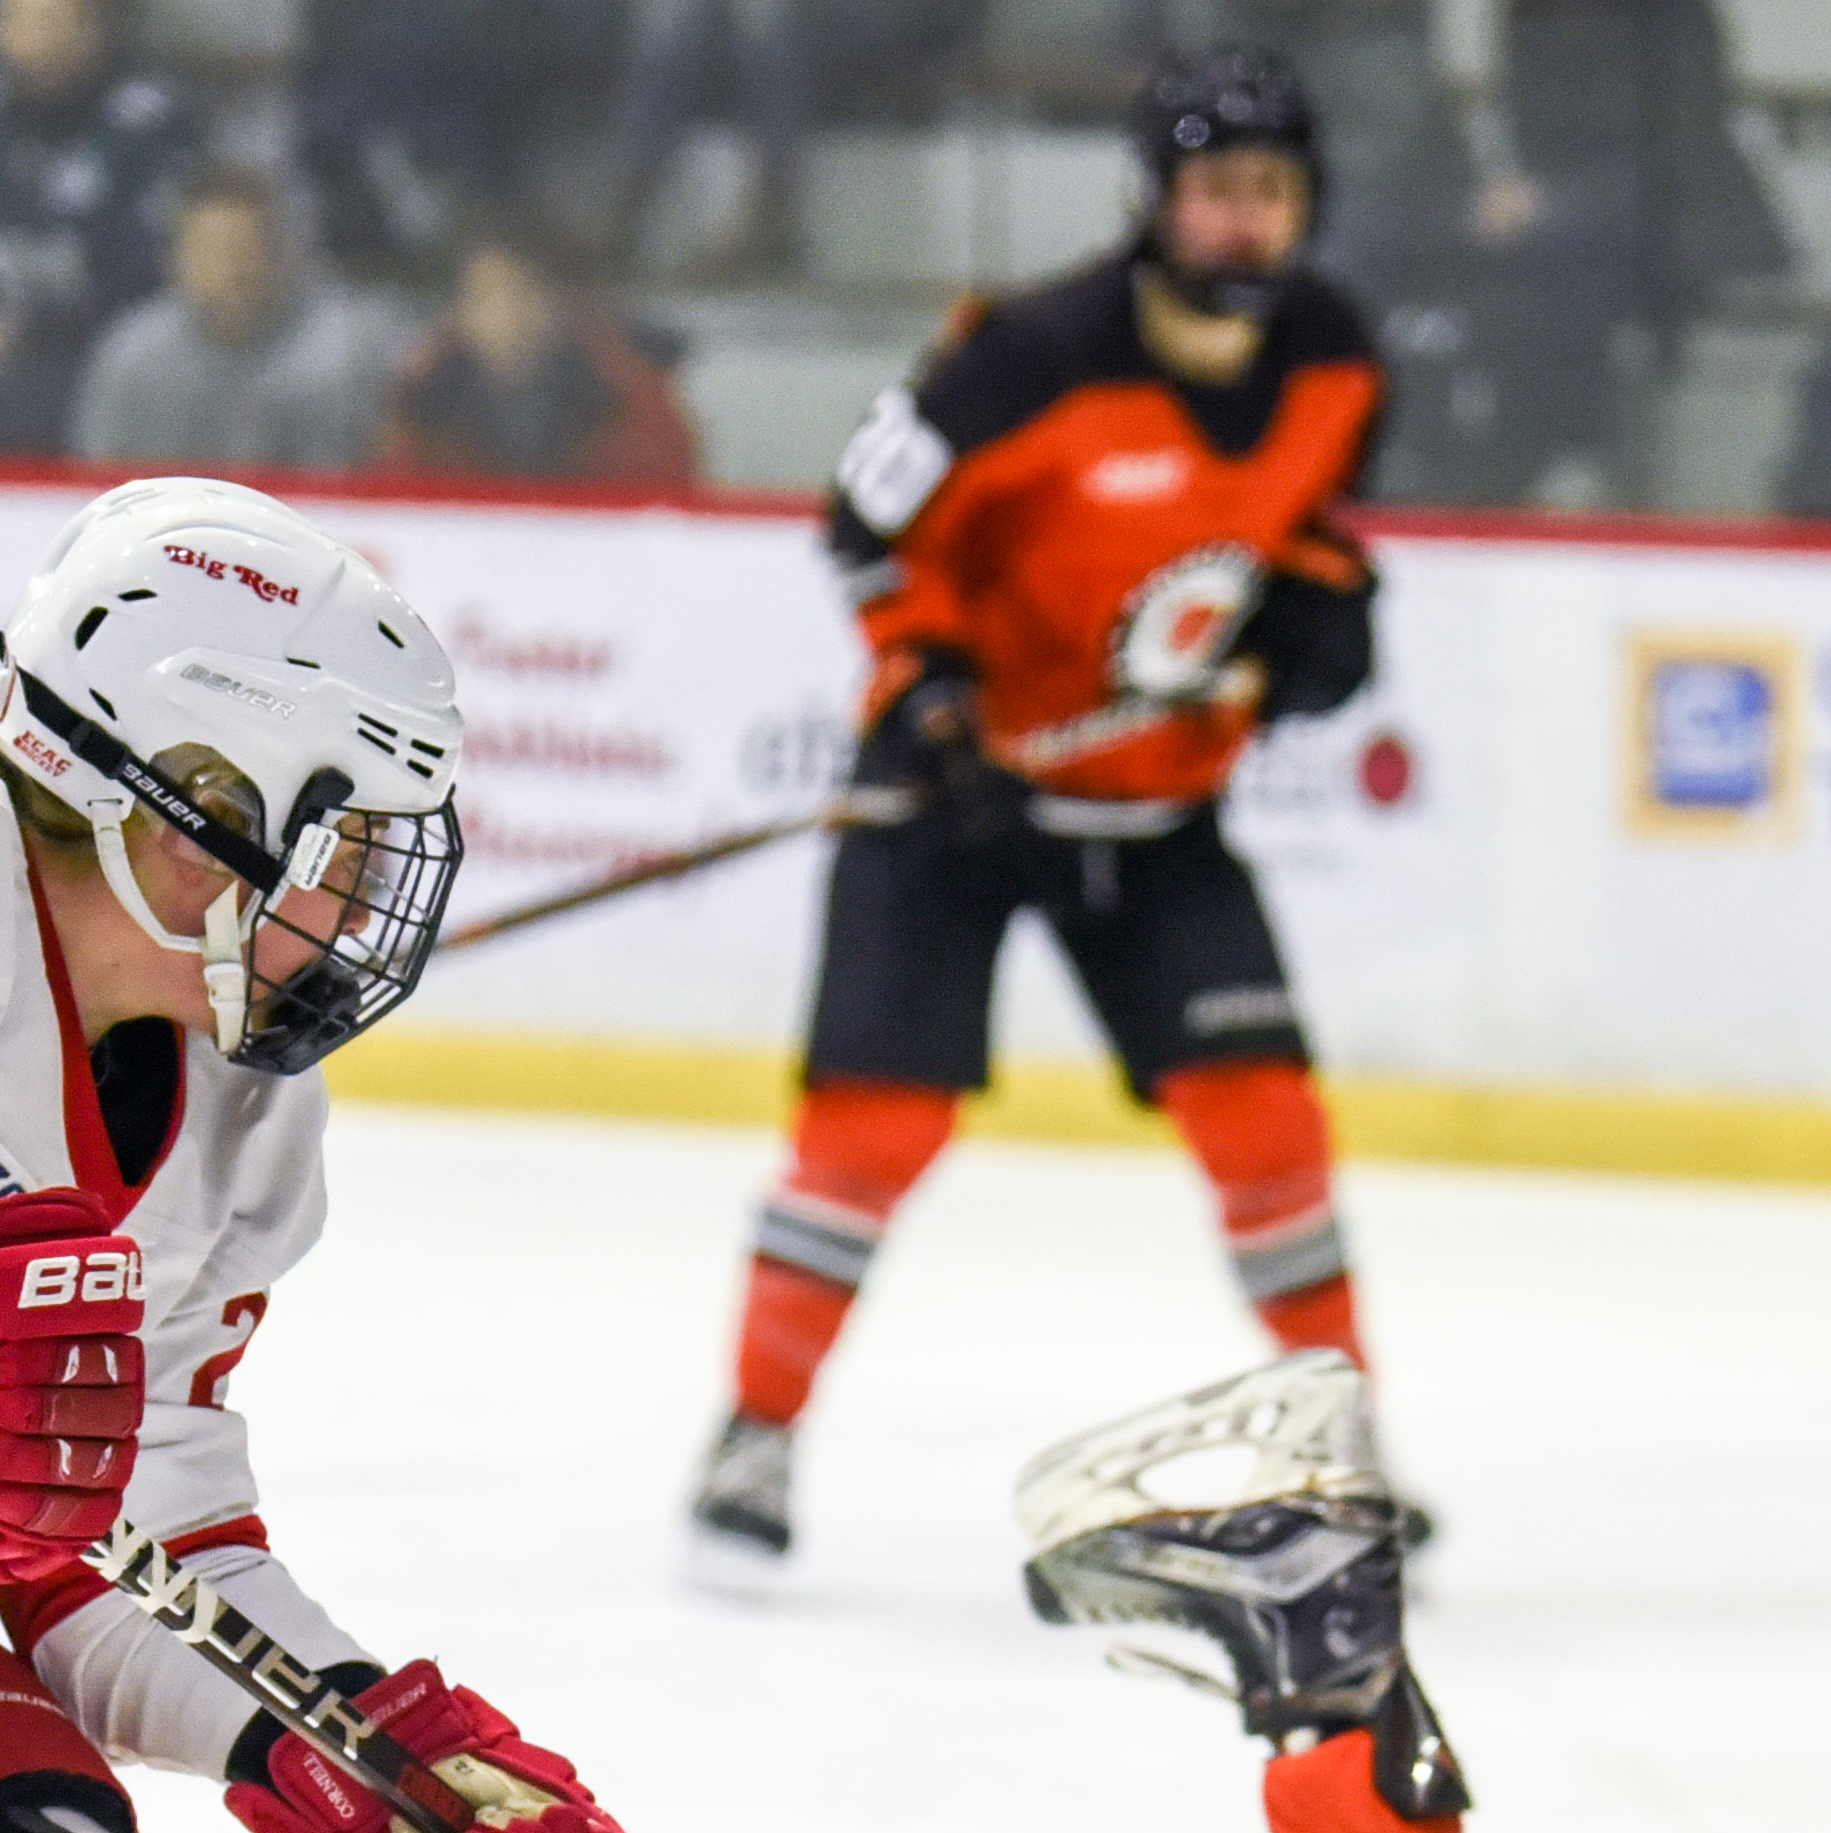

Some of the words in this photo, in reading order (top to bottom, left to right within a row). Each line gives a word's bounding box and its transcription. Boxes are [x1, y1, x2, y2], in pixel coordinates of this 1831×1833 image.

[163, 544, 229, 580] Big
[234, 564, 301, 606] Red
[20, 729, 73, 772] ECAC
[303, 1752, 356, 1819] CORNELL
